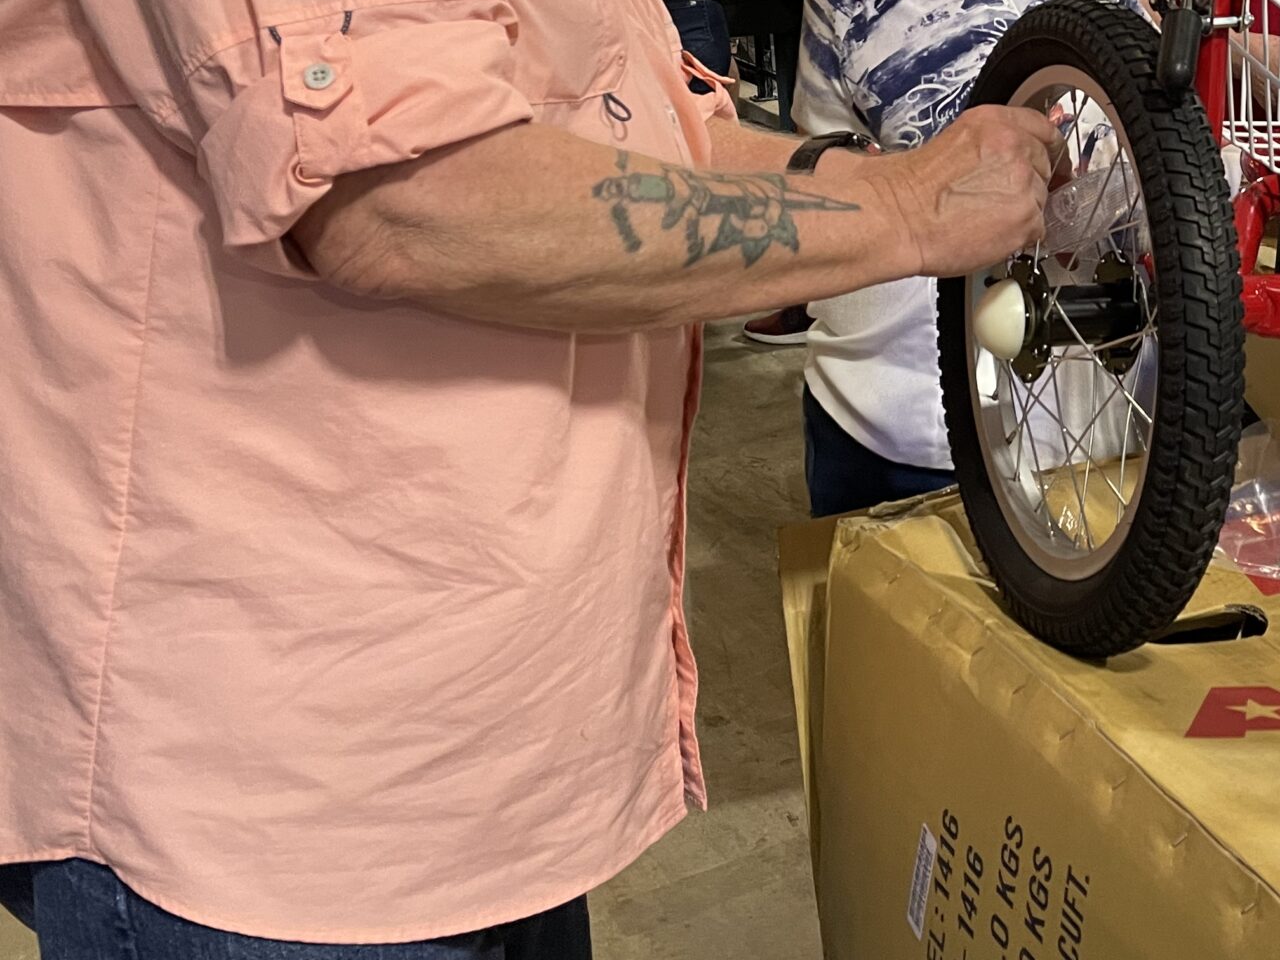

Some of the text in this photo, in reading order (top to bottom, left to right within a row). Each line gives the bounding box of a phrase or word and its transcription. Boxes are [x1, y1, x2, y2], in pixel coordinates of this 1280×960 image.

[934, 809, 959, 900] 1416
[958, 845, 983, 939] 1416
[996, 816, 1023, 909] KGS
[1024, 846, 1052, 944] KGS
